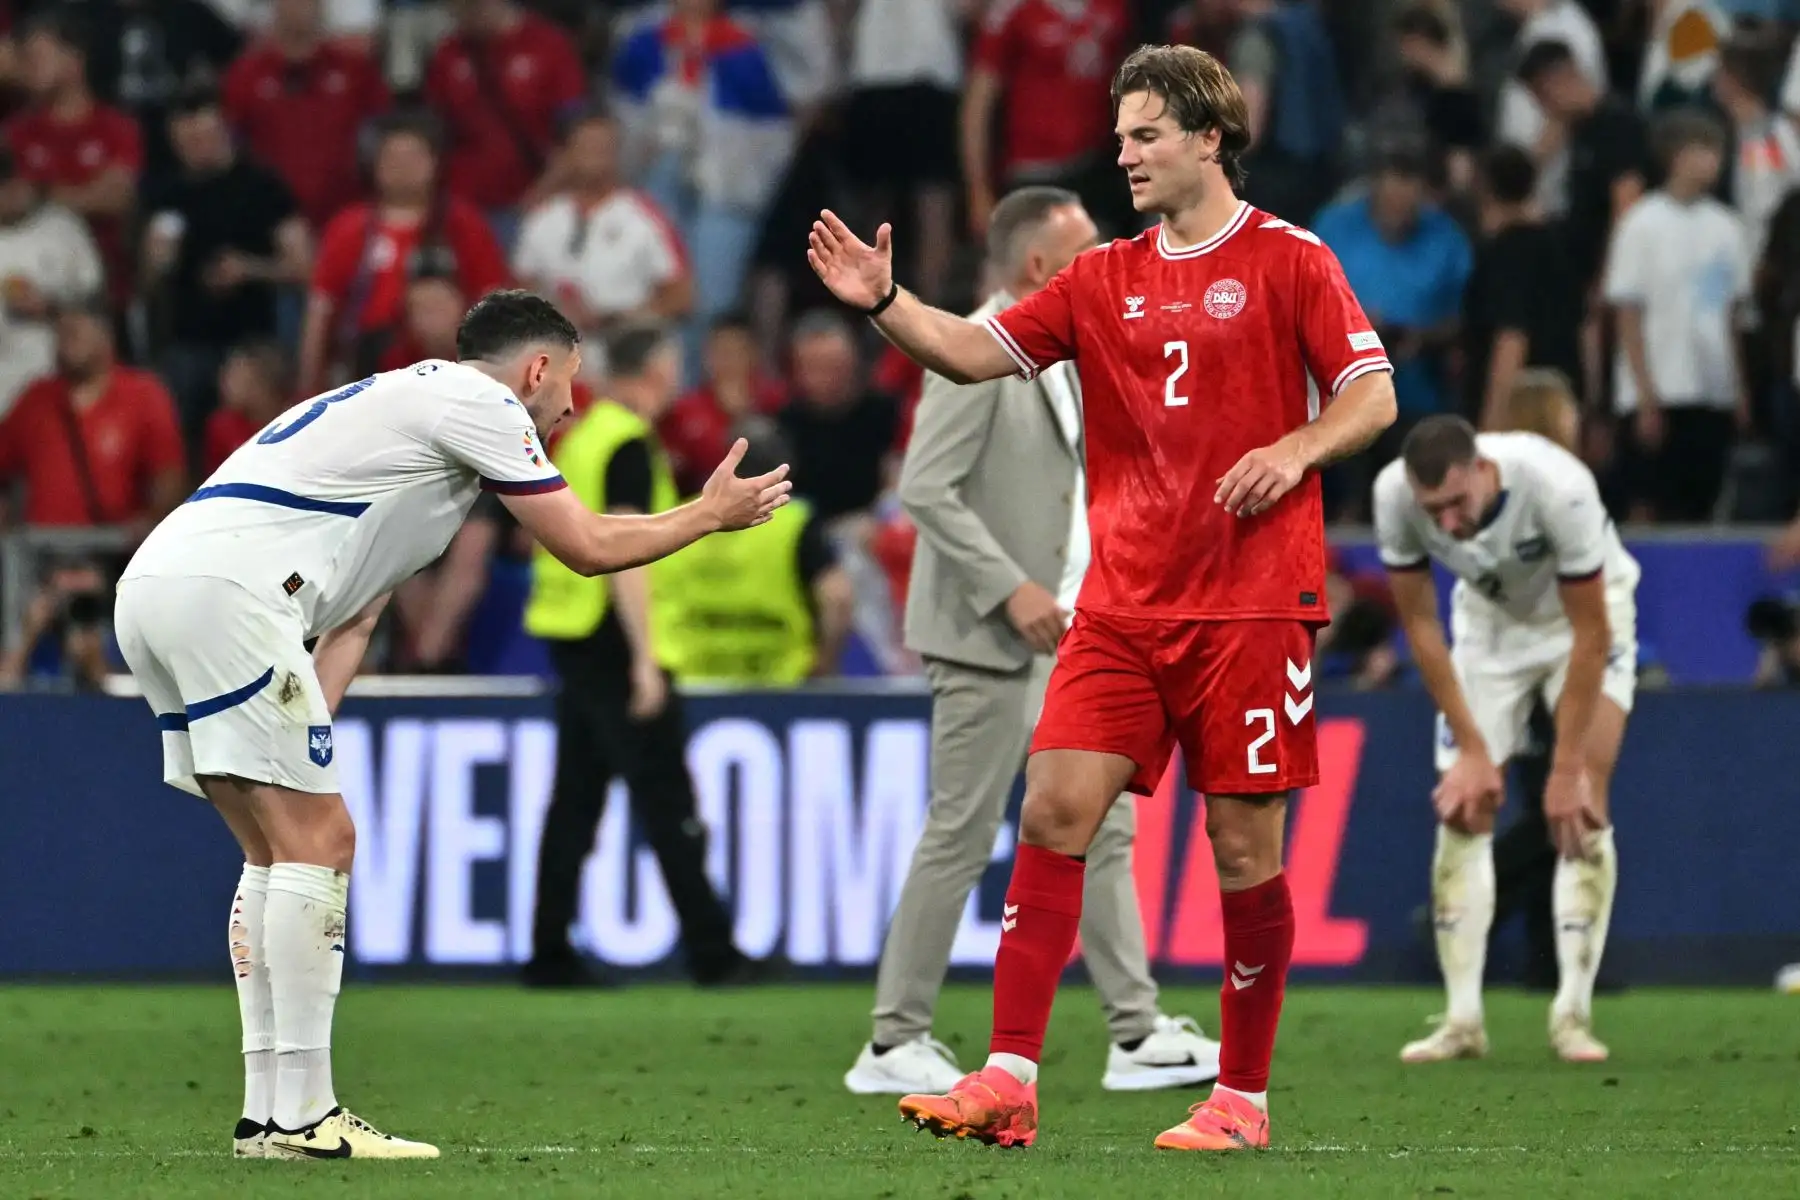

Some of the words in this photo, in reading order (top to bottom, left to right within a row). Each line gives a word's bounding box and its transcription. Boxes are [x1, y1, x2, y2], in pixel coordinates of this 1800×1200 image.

[1212, 292, 1238, 304] DBU
[1164, 341, 1189, 406] 2
[1246, 708, 1277, 774] 2
